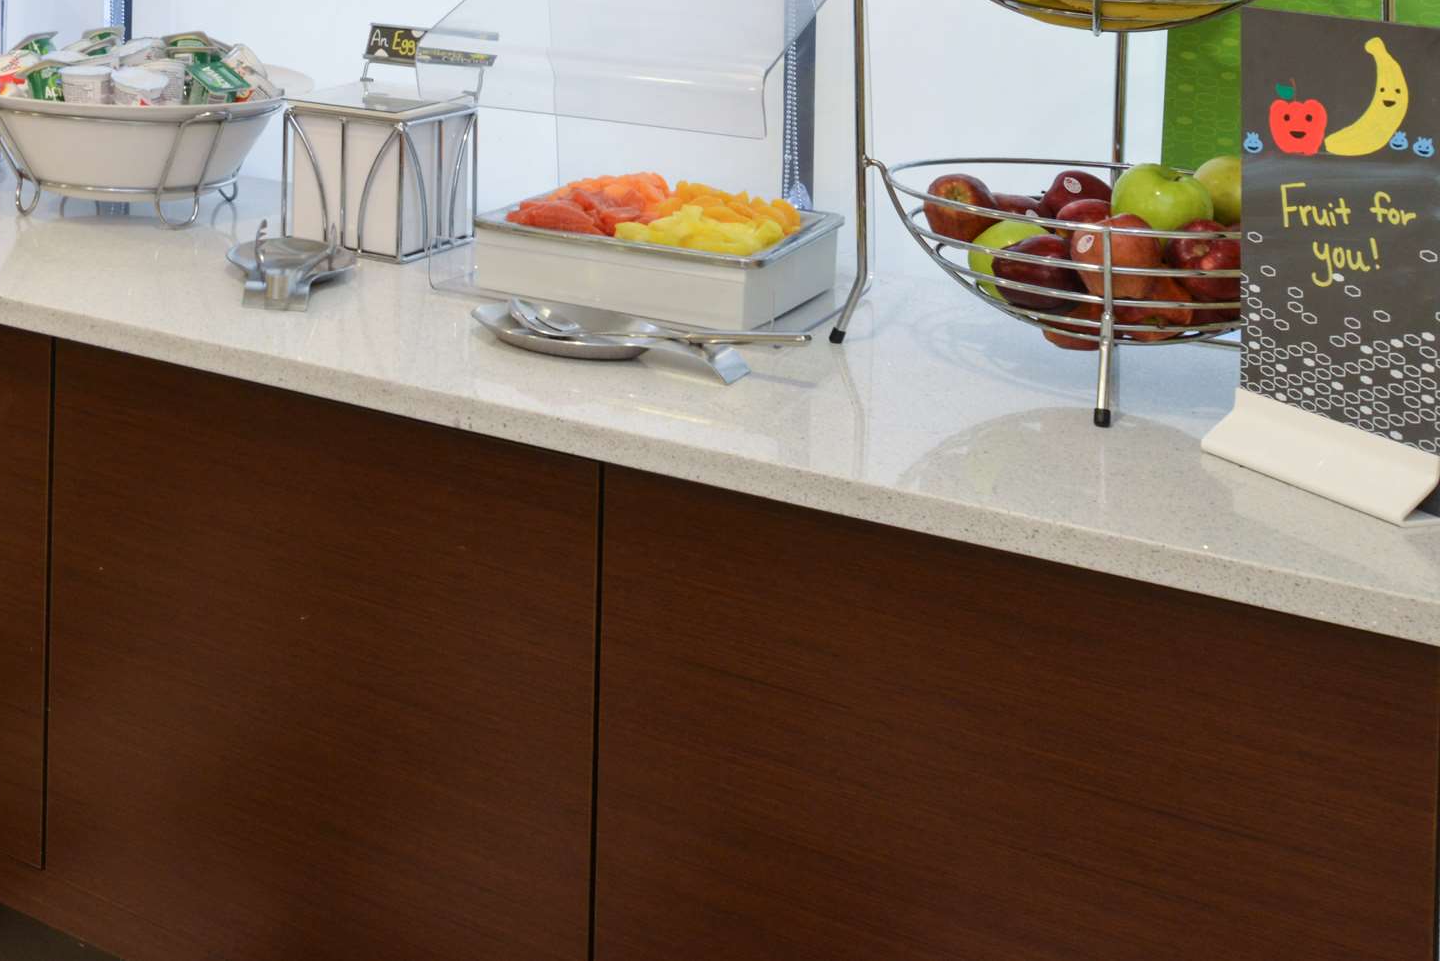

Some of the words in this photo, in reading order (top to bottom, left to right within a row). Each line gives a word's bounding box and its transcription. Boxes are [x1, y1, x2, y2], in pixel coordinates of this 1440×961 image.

[370, 29, 389, 48] An
[1279, 181, 1351, 228] Fruit
[1369, 190, 1418, 227] for
[1311, 236, 1381, 288] you!
